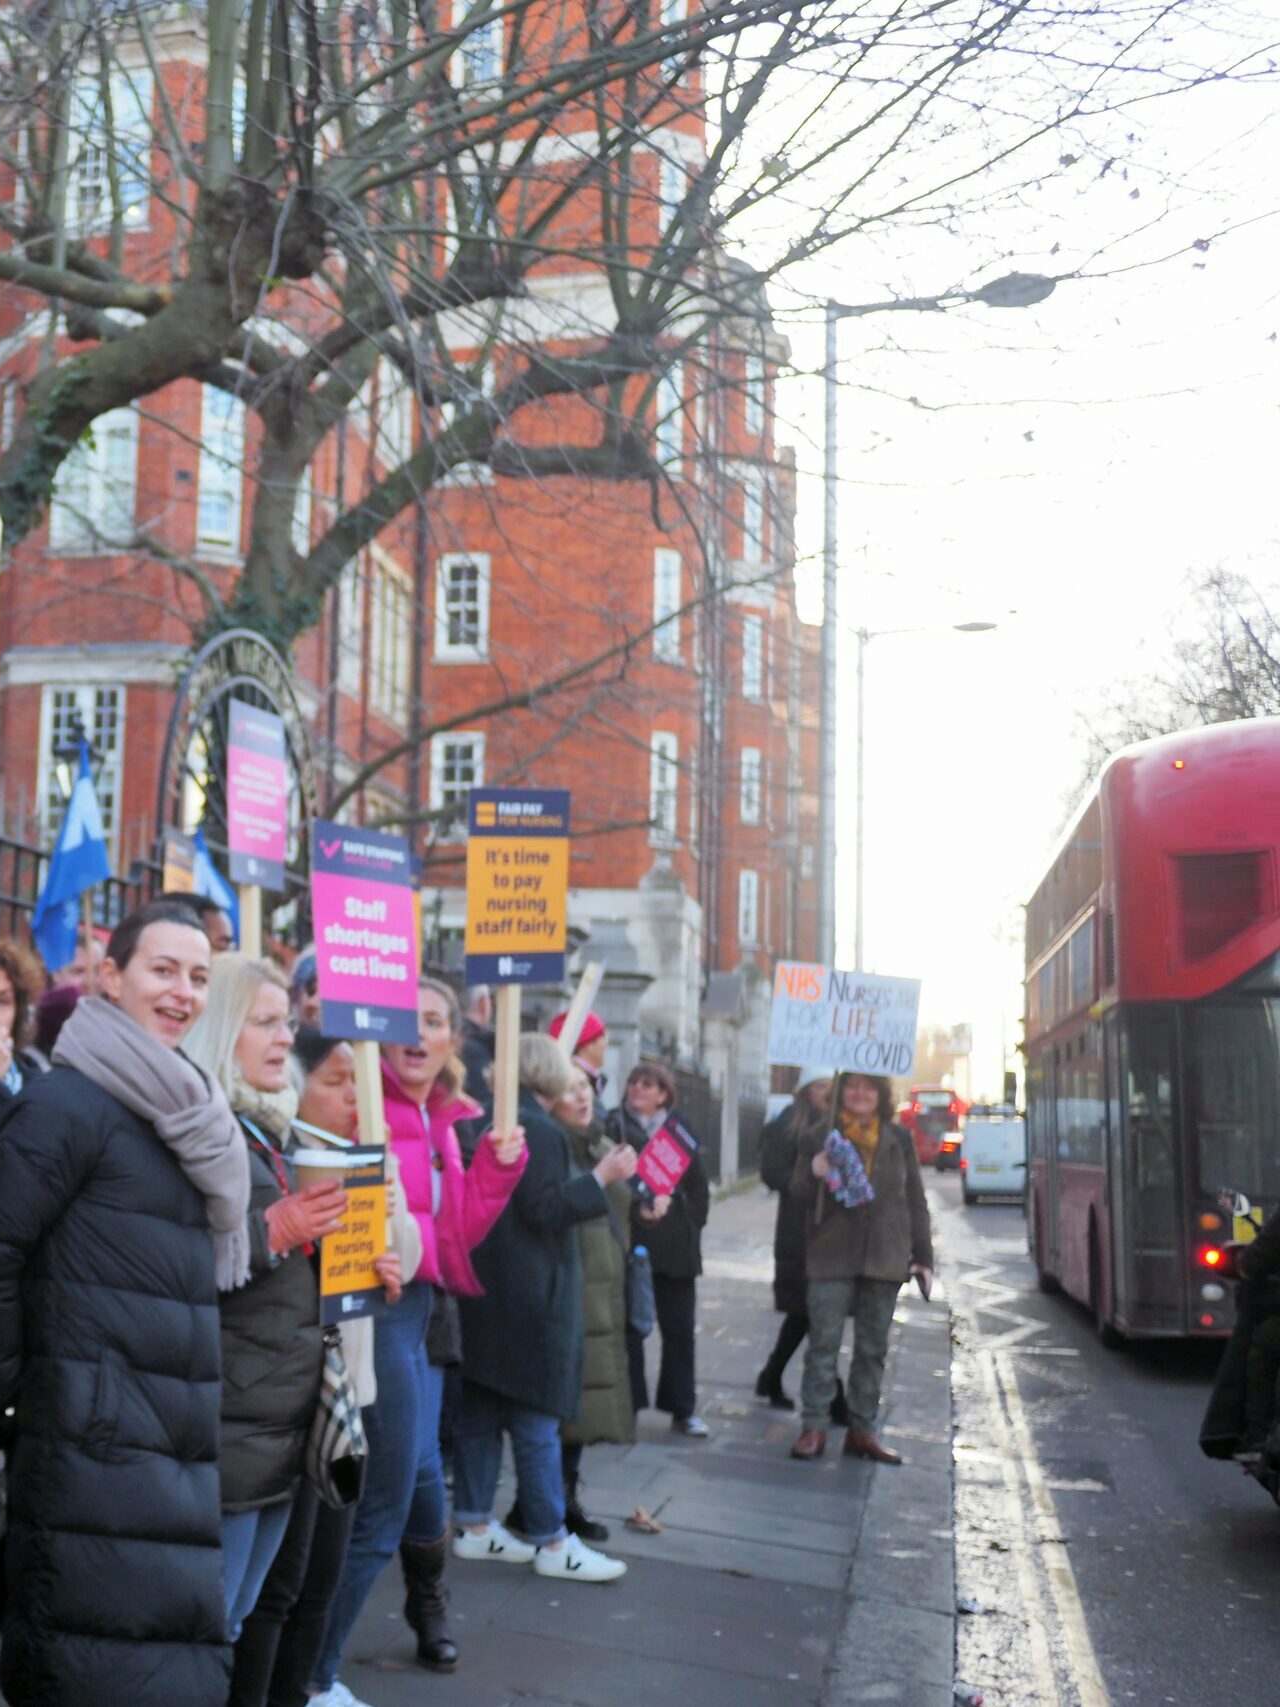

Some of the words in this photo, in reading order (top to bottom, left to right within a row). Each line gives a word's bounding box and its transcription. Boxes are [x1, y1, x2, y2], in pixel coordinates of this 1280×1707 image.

[497, 802, 522, 816] FAIR
[522, 802, 543, 816] PAY
[342, 839, 367, 856] SAFE
[514, 849, 551, 864] time
[493, 874, 510, 888] to
[513, 876, 542, 891] pay
[344, 896, 388, 923] Staff
[486, 896, 548, 914] nursing
[476, 918, 513, 935] staff
[516, 917, 557, 937] fairly
[323, 922, 409, 955] shortages
[329, 954, 368, 978] cost
[368, 954, 408, 982] lives
[774, 963, 826, 1003] NHS
[785, 1002, 825, 1031] FOR
[831, 1005, 880, 1040] LIFE
[853, 1037, 913, 1075] COVID
[351, 1199, 375, 1214] time
[351, 1220, 369, 1235] pay
[333, 1237, 375, 1257] nursing
[326, 1259, 351, 1279] staff
